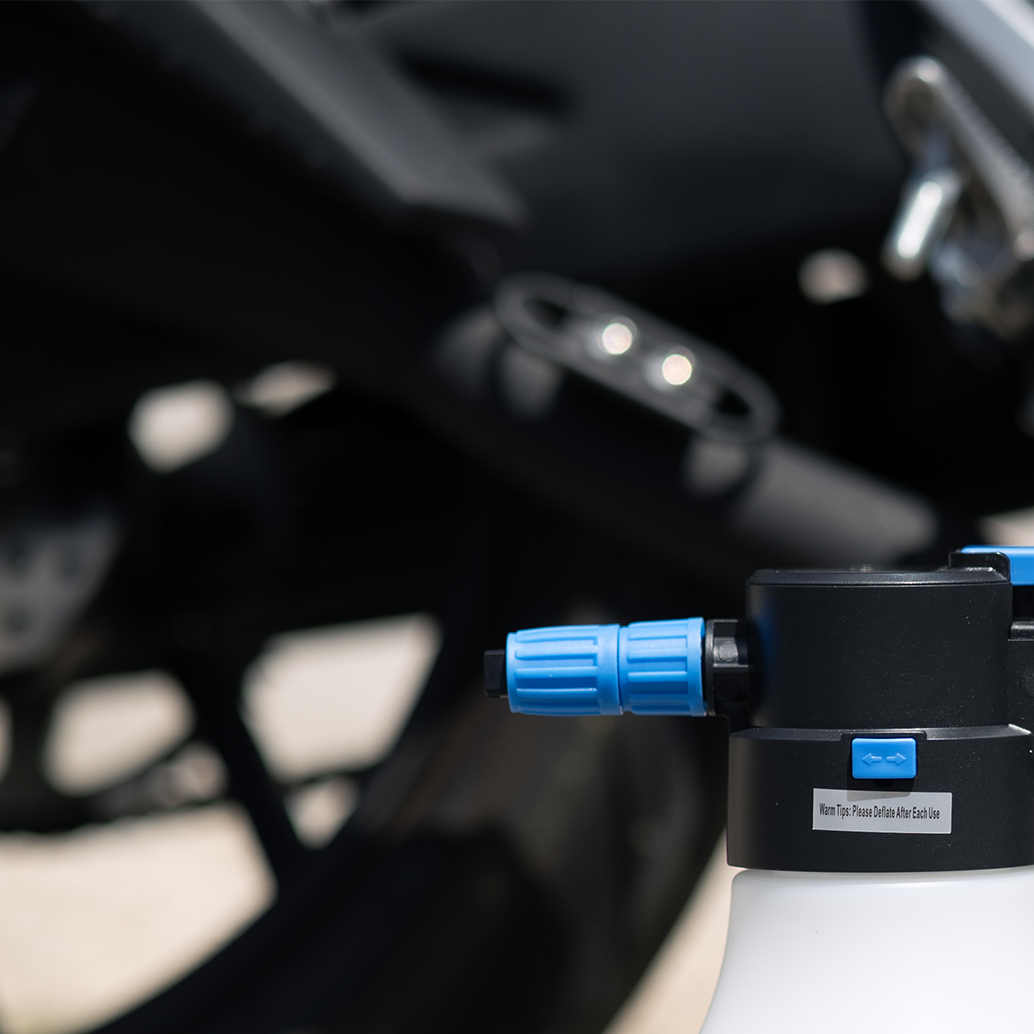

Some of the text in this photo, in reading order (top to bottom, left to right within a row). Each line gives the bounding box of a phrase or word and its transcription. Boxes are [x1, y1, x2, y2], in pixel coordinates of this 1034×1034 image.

[819, 803, 941, 820] Warm Tips: Please Deflate After Each Use
